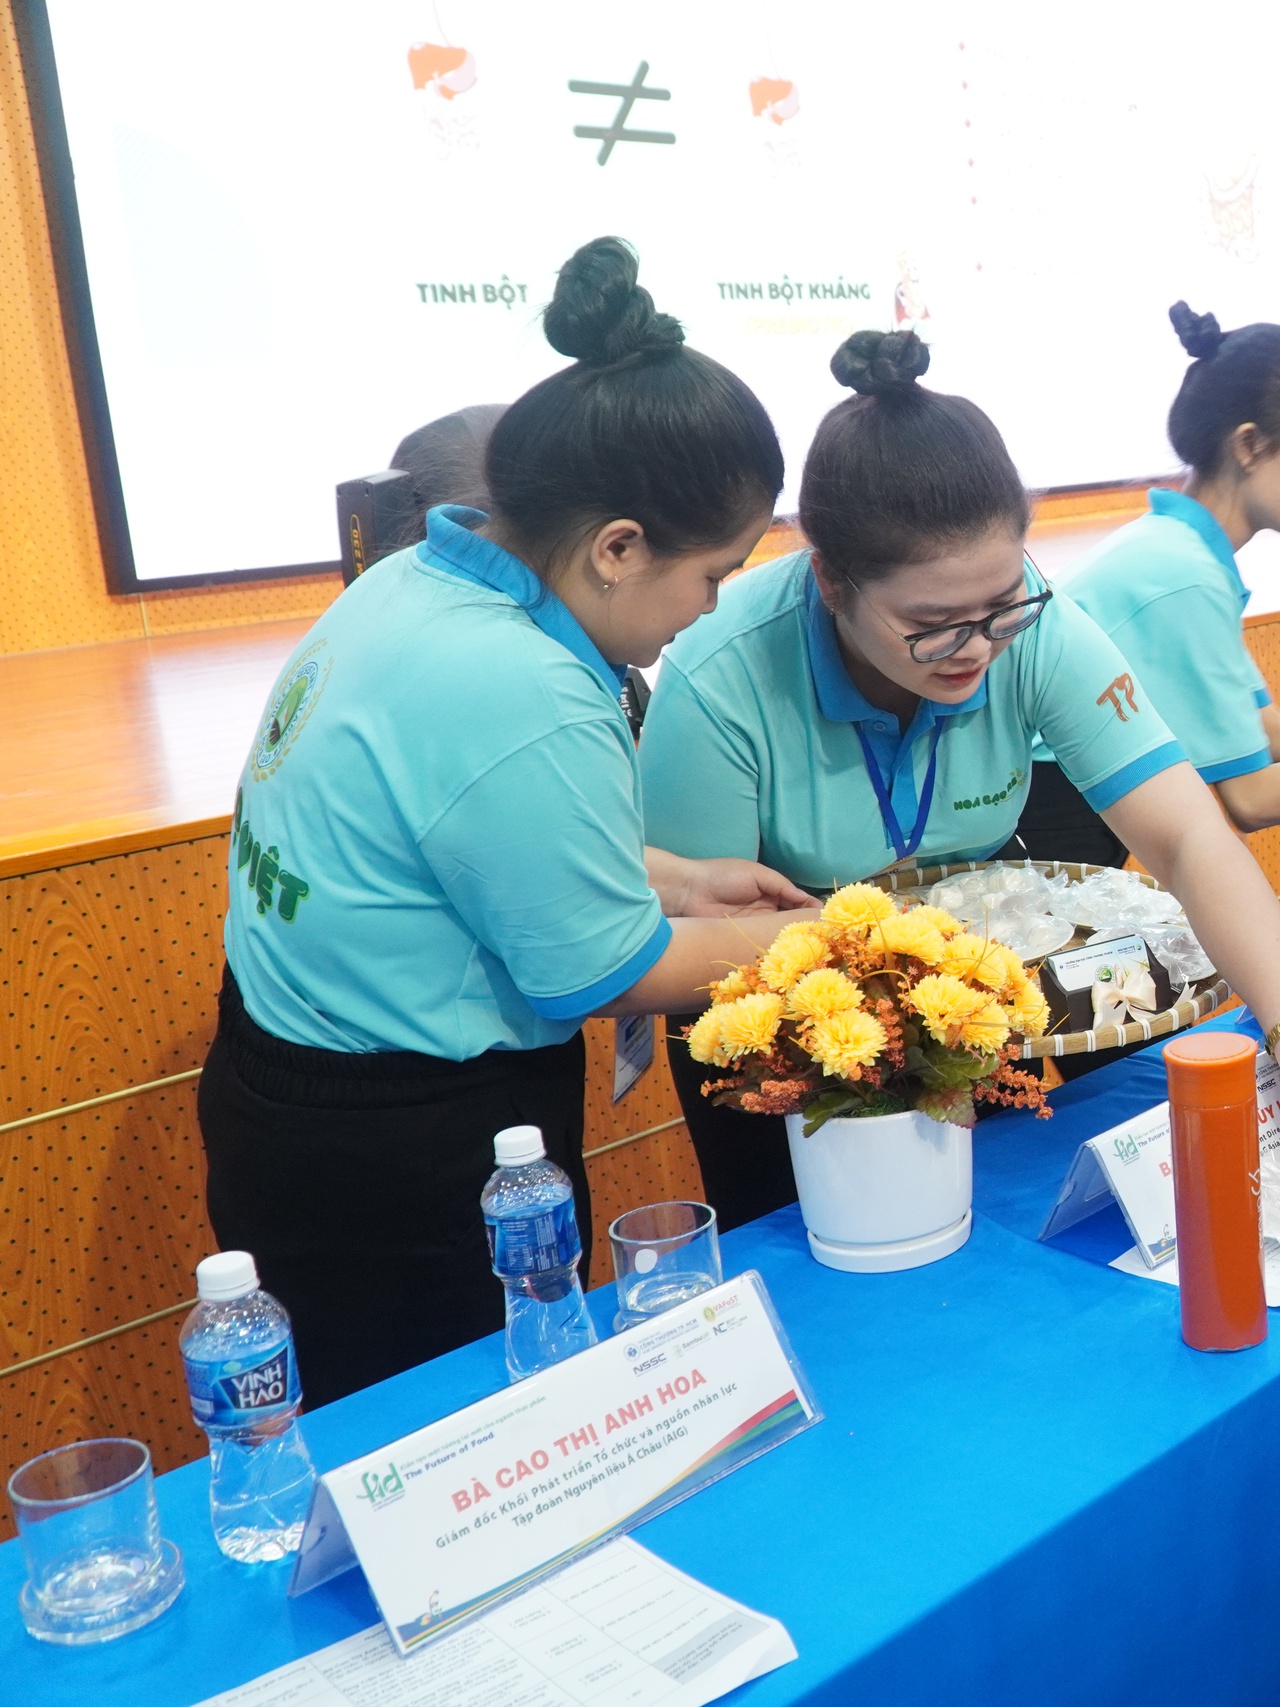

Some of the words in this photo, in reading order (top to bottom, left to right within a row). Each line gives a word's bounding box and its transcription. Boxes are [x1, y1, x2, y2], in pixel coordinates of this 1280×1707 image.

[416, 283, 476, 303] TINH
[482, 274, 528, 310] BỘT
[717, 282, 763, 300] TINH
[768, 274, 803, 306] BỘT
[808, 275, 871, 300] KHÁNG
[352, 528, 362, 559] 230
[1096, 672, 1139, 722] TP
[1257, 1078, 1277, 1092] NSSC
[1138, 1140, 1148, 1148] The
[1148, 1131, 1165, 1142] Future
[1268, 1141, 1280, 1150] Asia
[1158, 1161, 1171, 1178] B
[712, 1322, 727, 1336] NC
[633, 1352, 667, 1376] NSSC
[451, 1477, 492, 1513] BÀ
[495, 1449, 549, 1489] CAO
[553, 1423, 601, 1458] THỊ
[604, 1394, 654, 1435] ANH
[656, 1368, 707, 1406] HOA
[404, 1468, 423, 1481] The
[425, 1451, 456, 1471] Future
[459, 1444, 469, 1454] of
[471, 1432, 495, 1448] Food
[436, 1524, 470, 1549] Giám
[474, 1510, 498, 1529] đốc
[499, 1494, 529, 1516] Khối
[531, 1475, 561, 1498] Phát
[562, 1458, 593, 1482] triển
[612, 1433, 638, 1456] chức
[639, 1426, 653, 1440] và
[692, 1393, 720, 1412] nhân
[720, 1382, 738, 1397] lực
[511, 1507, 534, 1528] Tập
[535, 1493, 563, 1516] đoàn
[563, 1472, 603, 1506] Nguyên
[602, 1458, 626, 1481] liệu
[627, 1450, 637, 1467] Á
[636, 1441, 663, 1460] Châu
[663, 1425, 689, 1447] (AIG)
